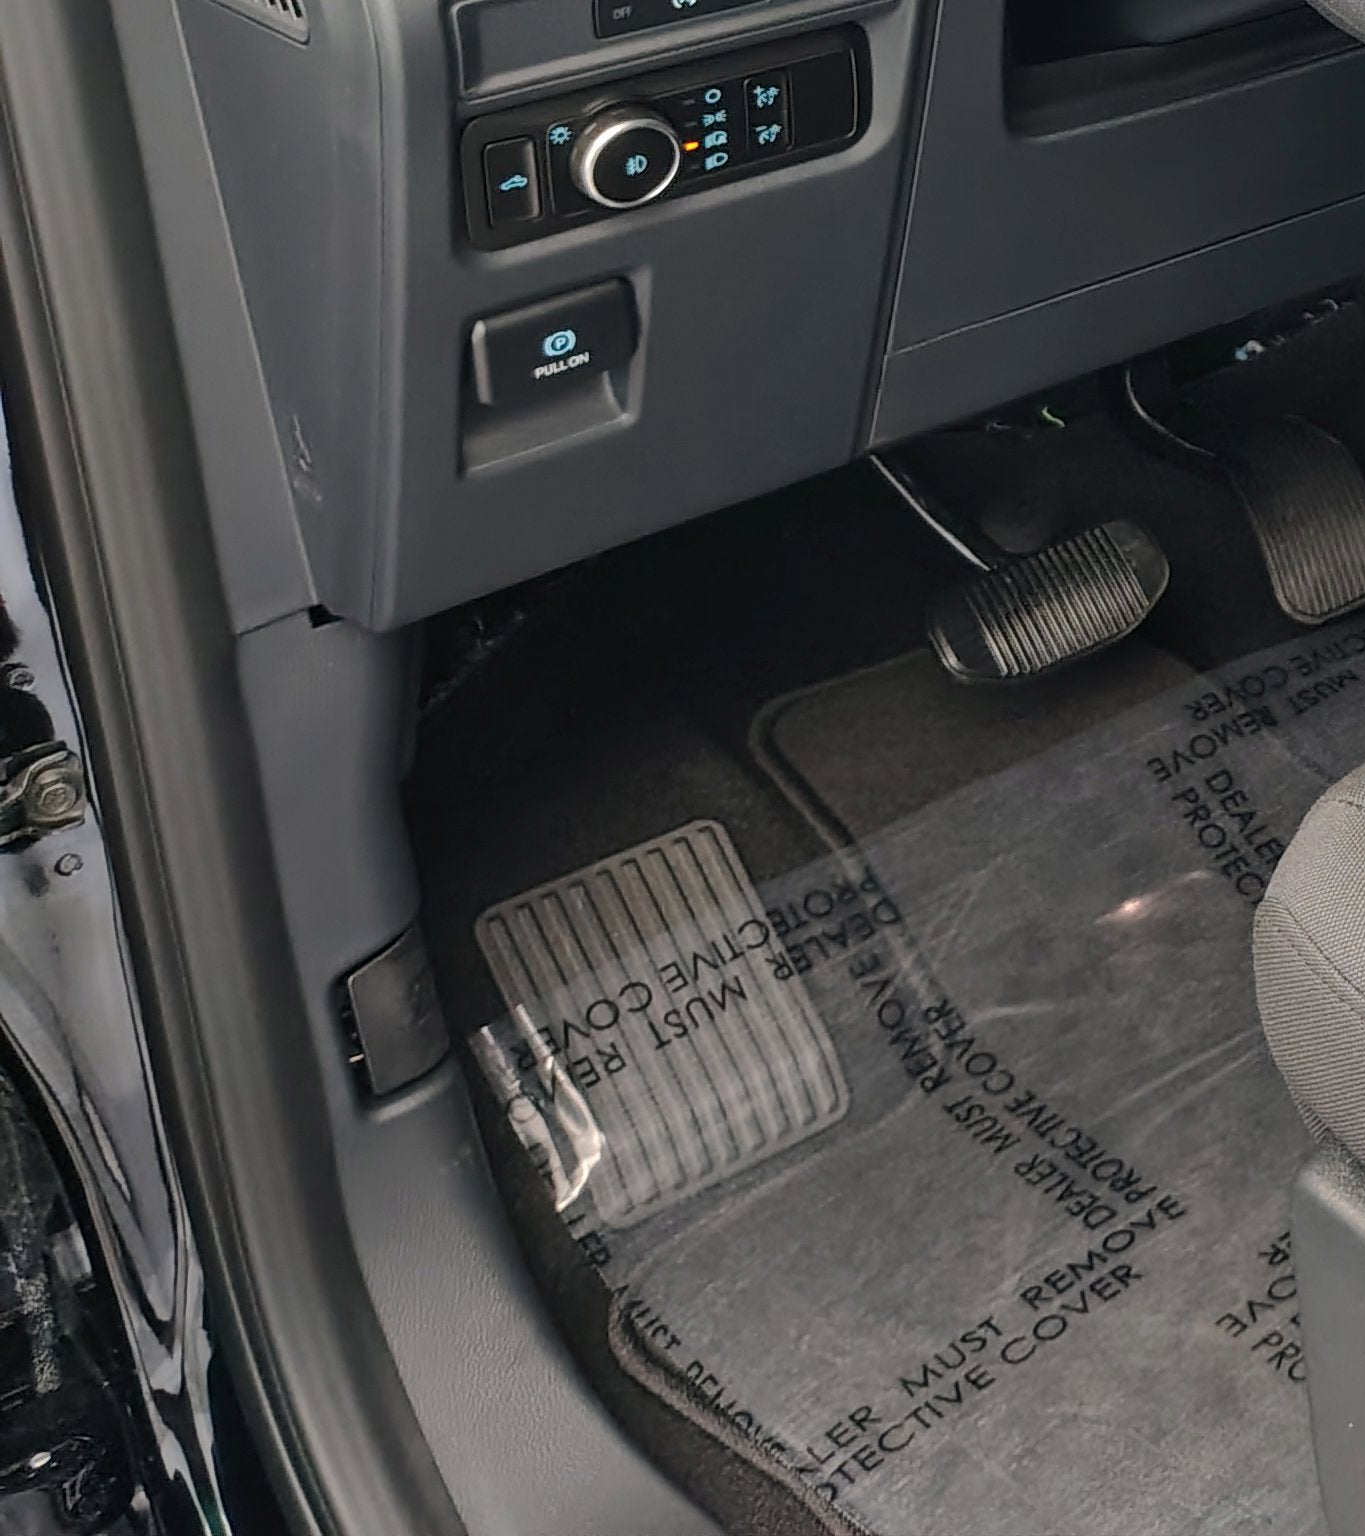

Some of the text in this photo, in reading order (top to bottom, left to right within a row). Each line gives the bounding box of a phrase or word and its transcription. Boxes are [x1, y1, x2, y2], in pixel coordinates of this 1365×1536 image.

[612, 5, 633, 21] OFF
[533, 351, 590, 380] PULL ON
[1185, 664, 1290, 723] COVER
[1288, 667, 1361, 716] MUST
[1146, 704, 1279, 783] REMOVE
[660, 865, 880, 993] PROTECTIVE
[764, 896, 901, 982] DEALER
[649, 973, 749, 1052] MUST
[848, 950, 1120, 1232] DEALER MUST REMOVE
[924, 997, 1159, 1205] PROTECTIVE COVER
[899, 1314, 1006, 1400] MUST
[1018, 1192, 1191, 1311] REMOVE
[999, 1260, 1146, 1367] COVER
